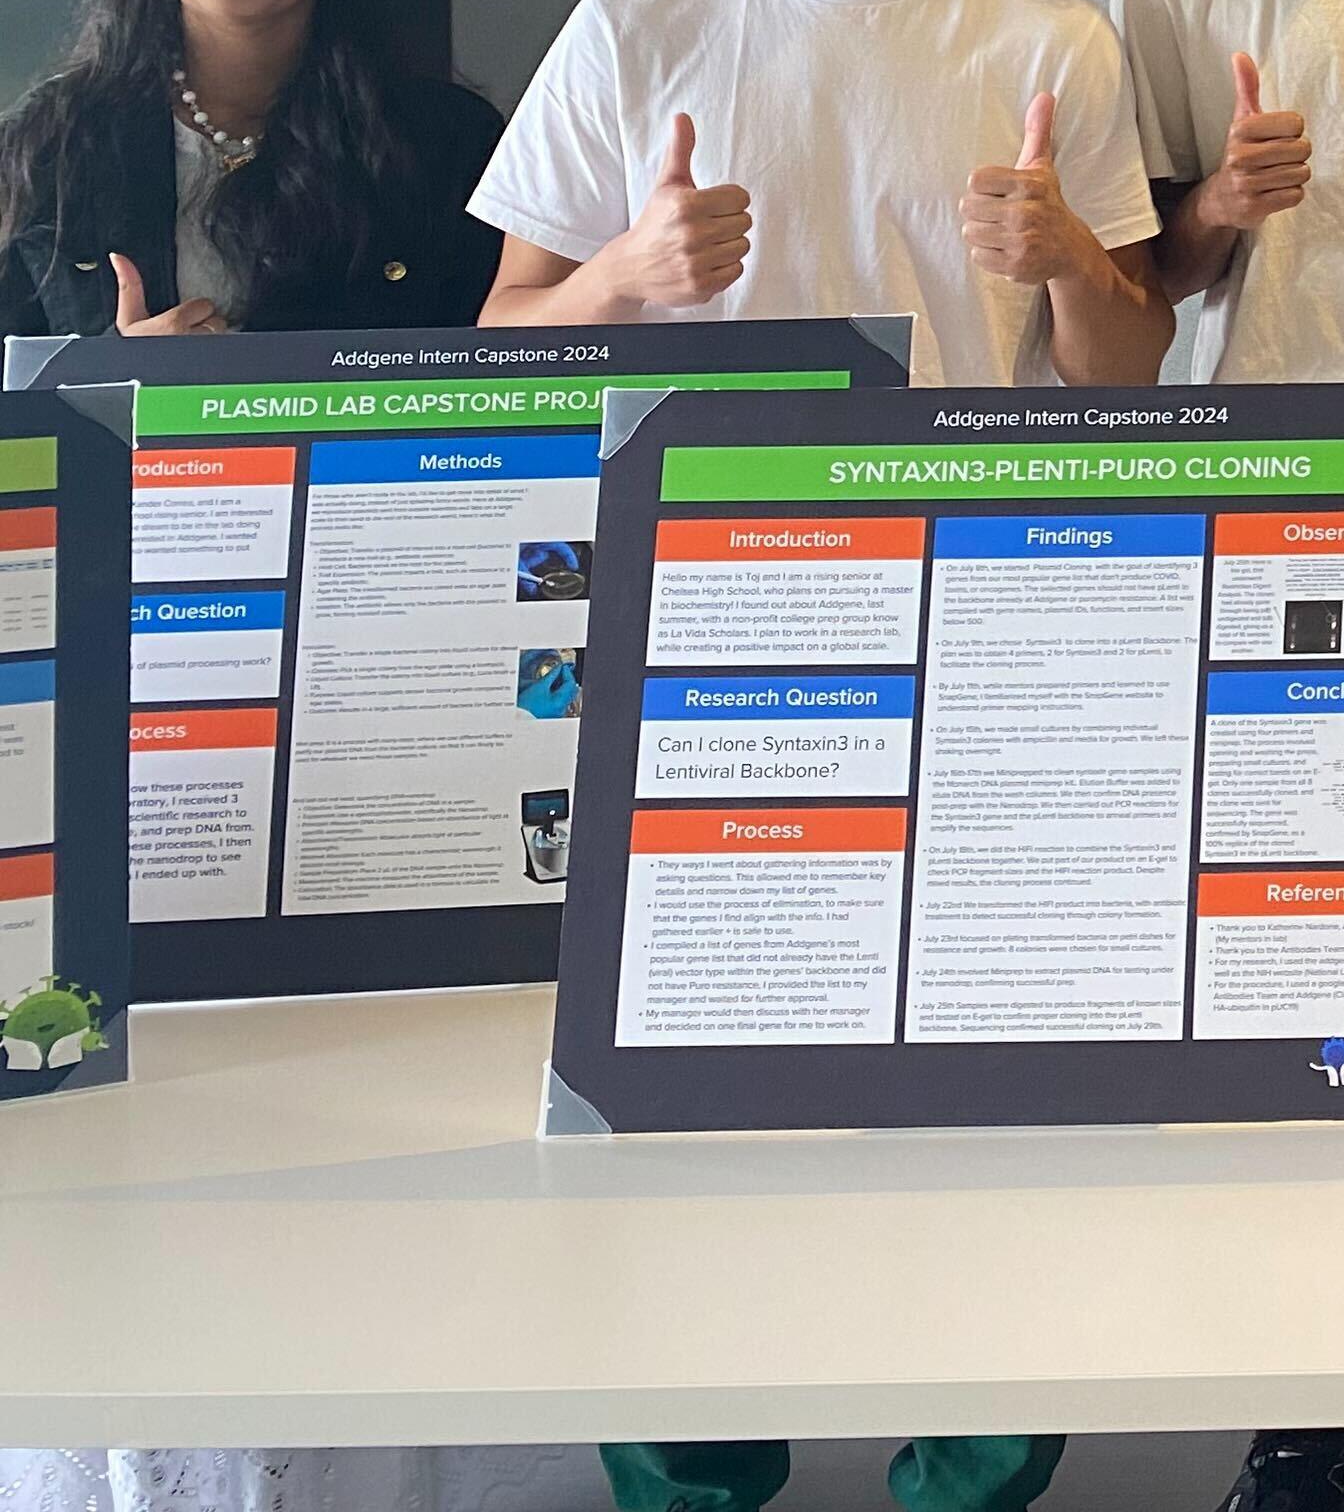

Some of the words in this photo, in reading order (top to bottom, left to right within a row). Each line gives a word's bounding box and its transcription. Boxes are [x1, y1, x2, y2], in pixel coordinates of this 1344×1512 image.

[331, 350, 413, 368] Addgene
[419, 349, 468, 363] Intern
[474, 347, 558, 364] Capstone
[563, 346, 609, 360] 2024
[202, 397, 317, 418] PLASMID
[326, 395, 375, 415] LAB
[384, 392, 526, 413] CAPSTONE
[534, 391, 600, 411] PROJ
[933, 410, 1019, 430] Addgene
[1025, 409, 1078, 425] Intern
[1084, 408, 1173, 428] Capstone
[1178, 407, 1228, 423] 2024
[132, 456, 223, 476] roduction
[420, 453, 501, 469] Methods
[829, 459, 1176, 482] SYNTAXIN3-PLENTI-PURO
[1185, 456, 1310, 478] CLONING
[730, 530, 850, 547] Introduction
[1027, 527, 1112, 548] Findings
[157, 602, 246, 619] Question
[685, 689, 778, 706] Research
[786, 688, 877, 705] Question
[129, 726, 186, 739] ocess
[658, 737, 691, 752] Can
[698, 736, 702, 751] I
[708, 737, 756, 751] clone
[762, 735, 847, 754] Syntaxin3
[854, 736, 868, 750] in
[875, 739, 884, 750] a
[656, 763, 734, 779] Lentiviral
[741, 763, 839, 778] Backbone?
[130, 783, 146, 792] ow
[151, 783, 183, 792] these
[185, 781, 243, 791] processes
[172, 796, 175, 805] I
[178, 794, 228, 805] received
[231, 793, 238, 803] 3
[182, 810, 232, 819] research
[235, 809, 247, 817] to
[140, 827, 162, 836] and
[165, 826, 192, 836] prep
[195, 823, 222, 833] DNA
[225, 822, 254, 832] from.
[722, 821, 803, 838] Process
[135, 870, 138, 879] I
[142, 869, 178, 879] ended
[181, 870, 196, 879] up
[198, 867, 226, 876] with.
